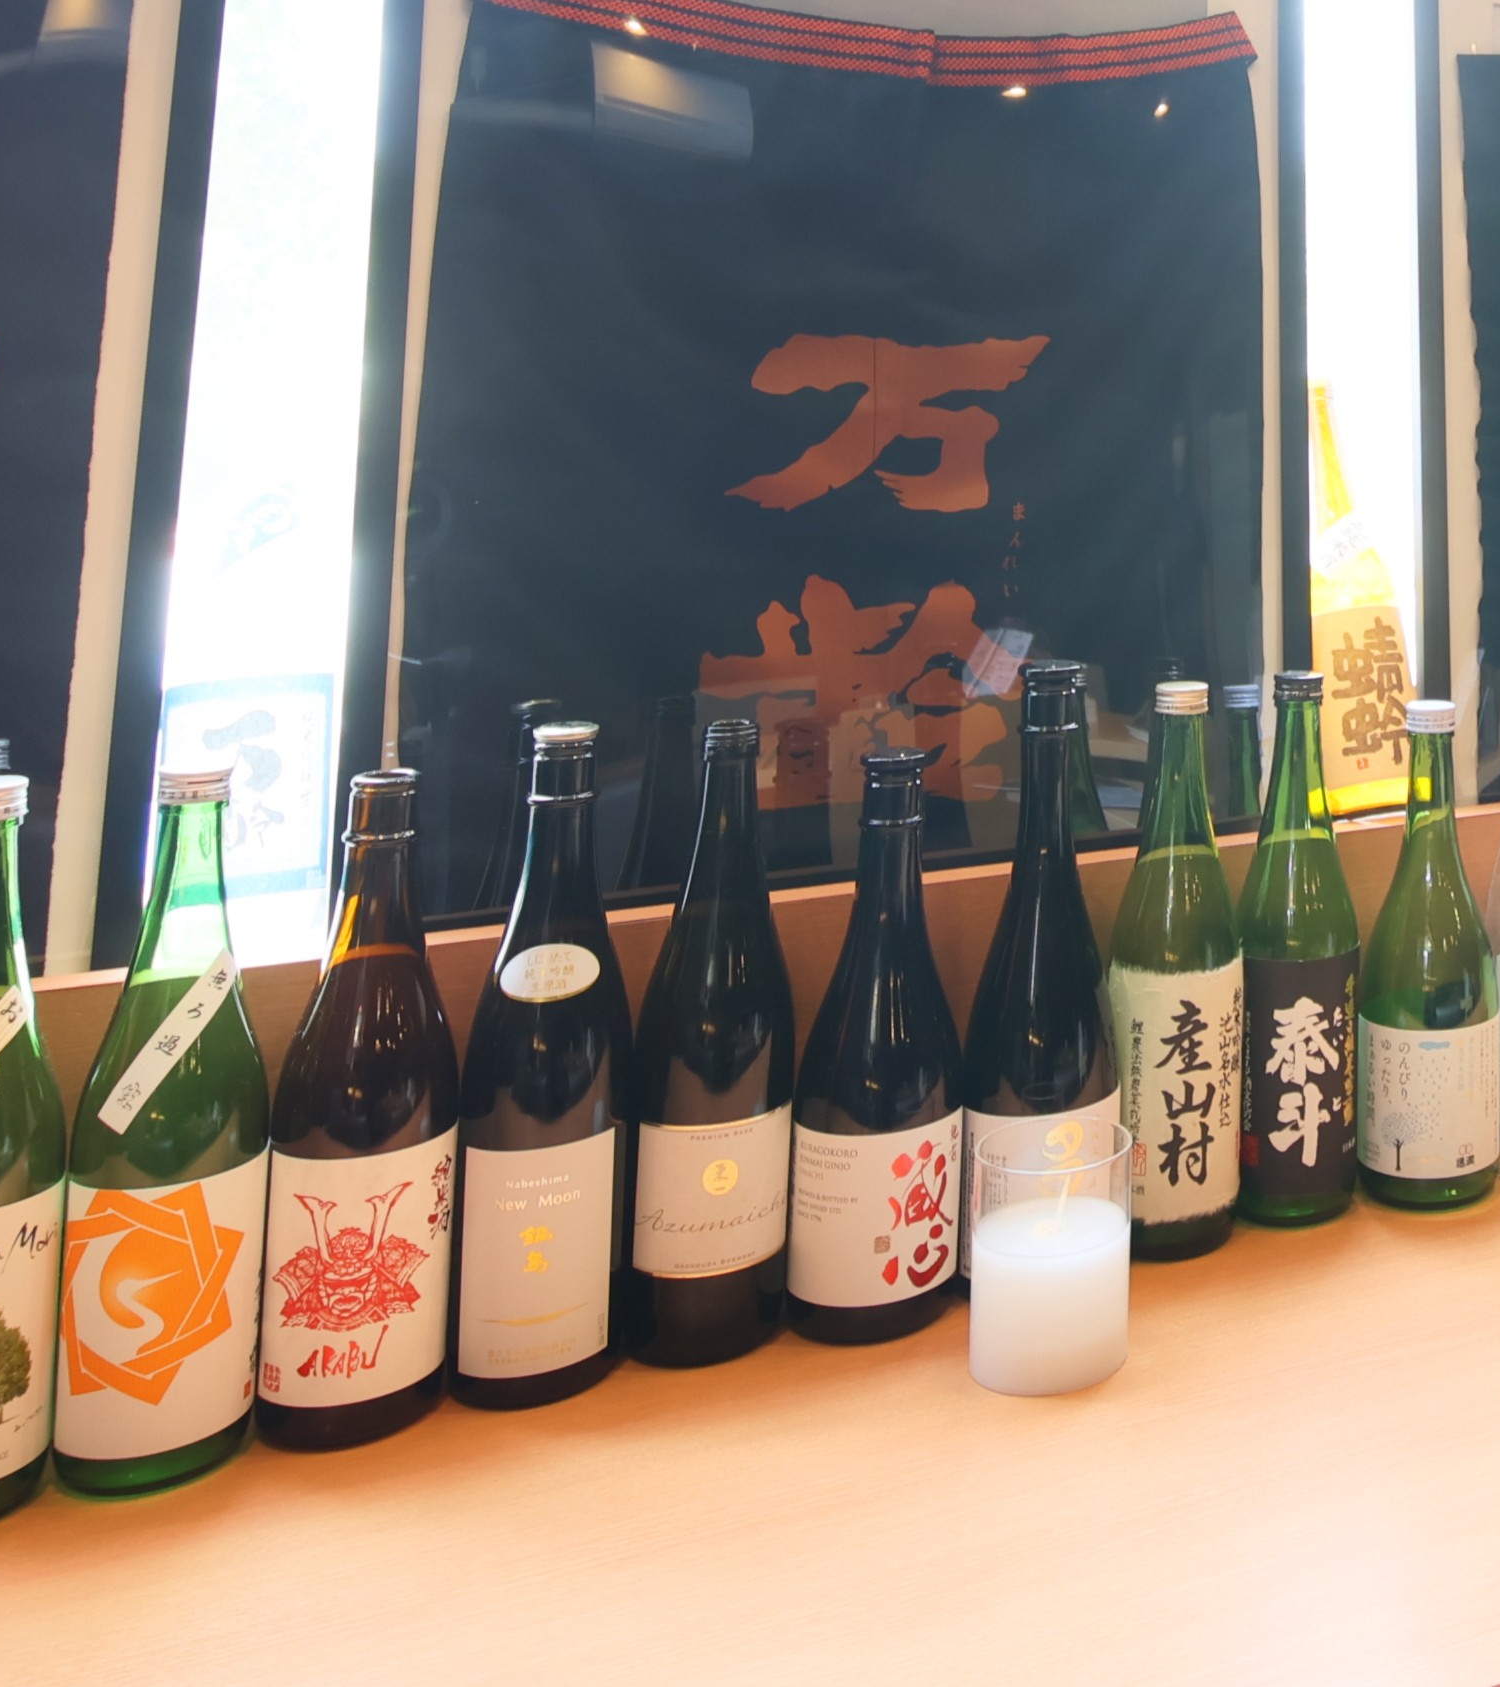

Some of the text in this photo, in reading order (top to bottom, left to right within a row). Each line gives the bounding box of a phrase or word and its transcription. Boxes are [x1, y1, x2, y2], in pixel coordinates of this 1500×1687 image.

[1003, 501, 1027, 599] まんれい
[1153, 999, 1217, 1188] 産山村
[1264, 995, 1341, 1168] 泰斗
[799, 1139, 859, 1159] KURAGOKORO
[493, 1188, 582, 1212] New Moon
[506, 1173, 570, 1190] Nabeshima
[297, 1323, 390, 1380] AKABU
